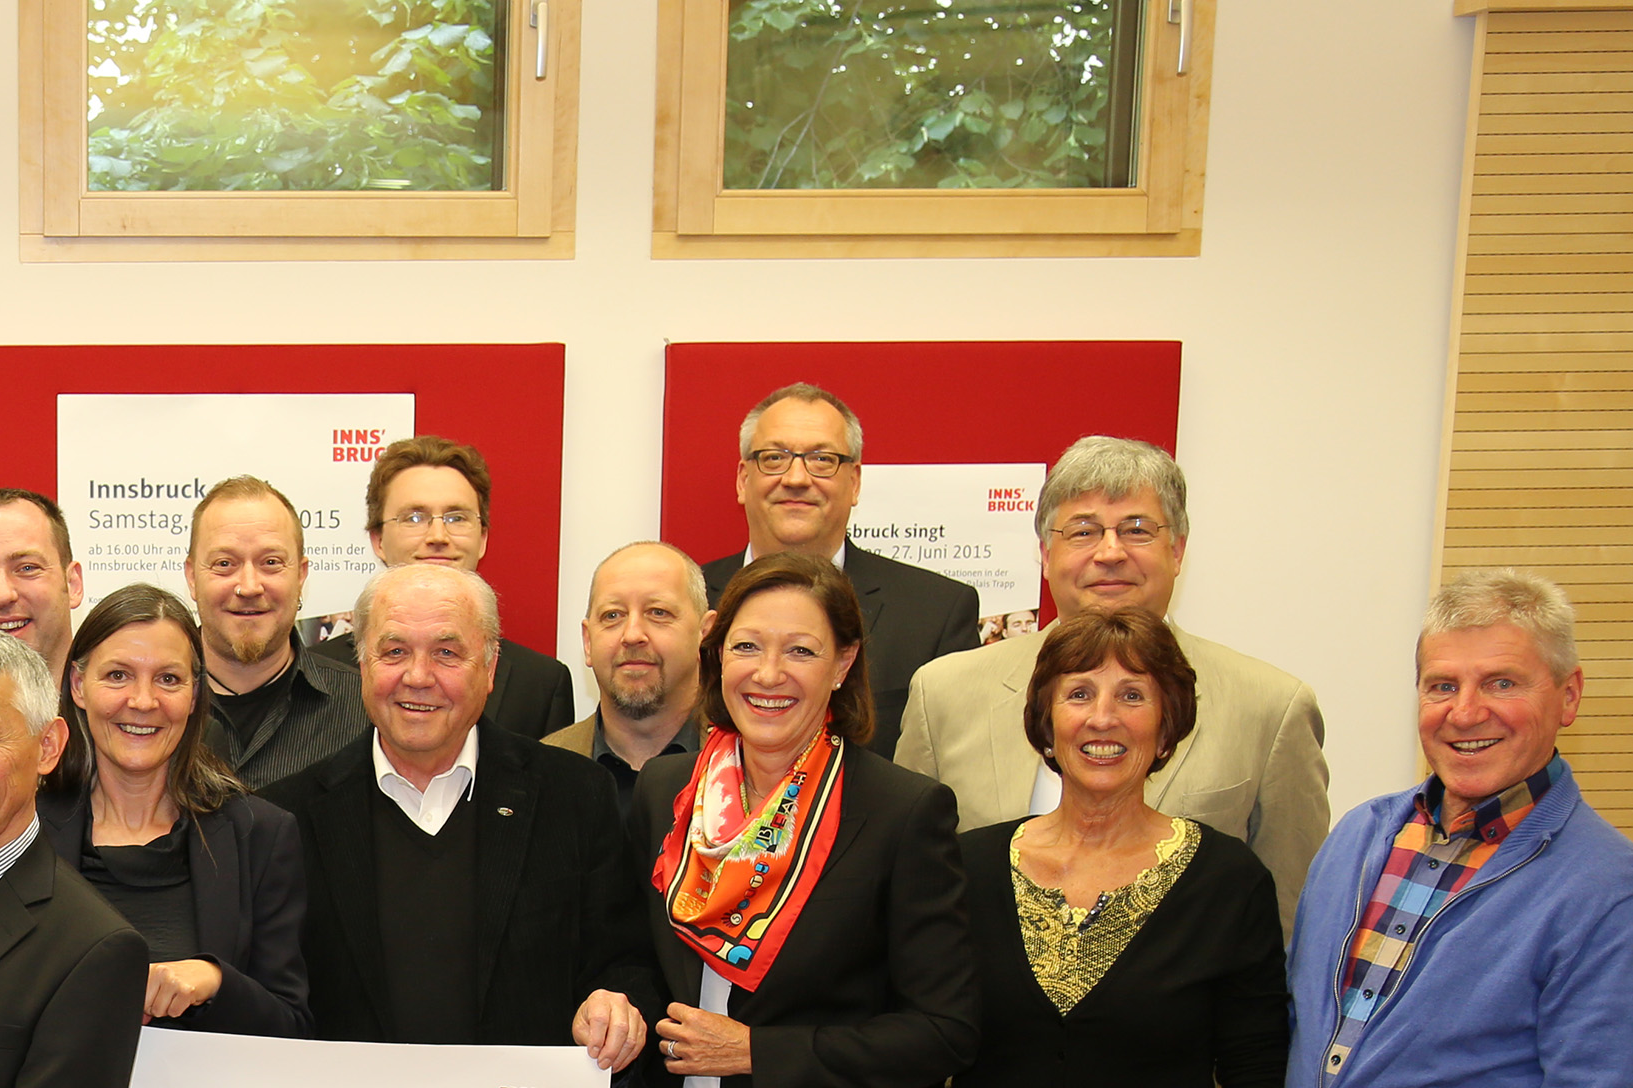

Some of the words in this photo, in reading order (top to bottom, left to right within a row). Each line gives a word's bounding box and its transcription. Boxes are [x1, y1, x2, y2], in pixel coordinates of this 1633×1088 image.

[333, 447, 386, 462] BRUC
[88, 478, 206, 500] Innsbruck
[987, 500, 1035, 512] BRUCK
[88, 509, 188, 535] Samstag,
[300, 509, 340, 529] 015
[846, 523, 900, 538] sbruck
[905, 523, 945, 542] singt
[88, 544, 103, 555] ab
[107, 544, 139, 555] 16.00
[143, 544, 163, 555] Uhr
[167, 546, 181, 555] an
[332, 544, 342, 555] in
[346, 544, 365, 555] der
[892, 545, 913, 559] 27.
[917, 544, 947, 563] Juni
[953, 544, 992, 559] 2015
[89, 560, 157, 571] Innsbrucker
[160, 560, 186, 571] Altst
[308, 560, 340, 571] Palais
[344, 560, 376, 574] Trapp
[943, 569, 982, 577] Stationen
[995, 569, 1008, 577] der
